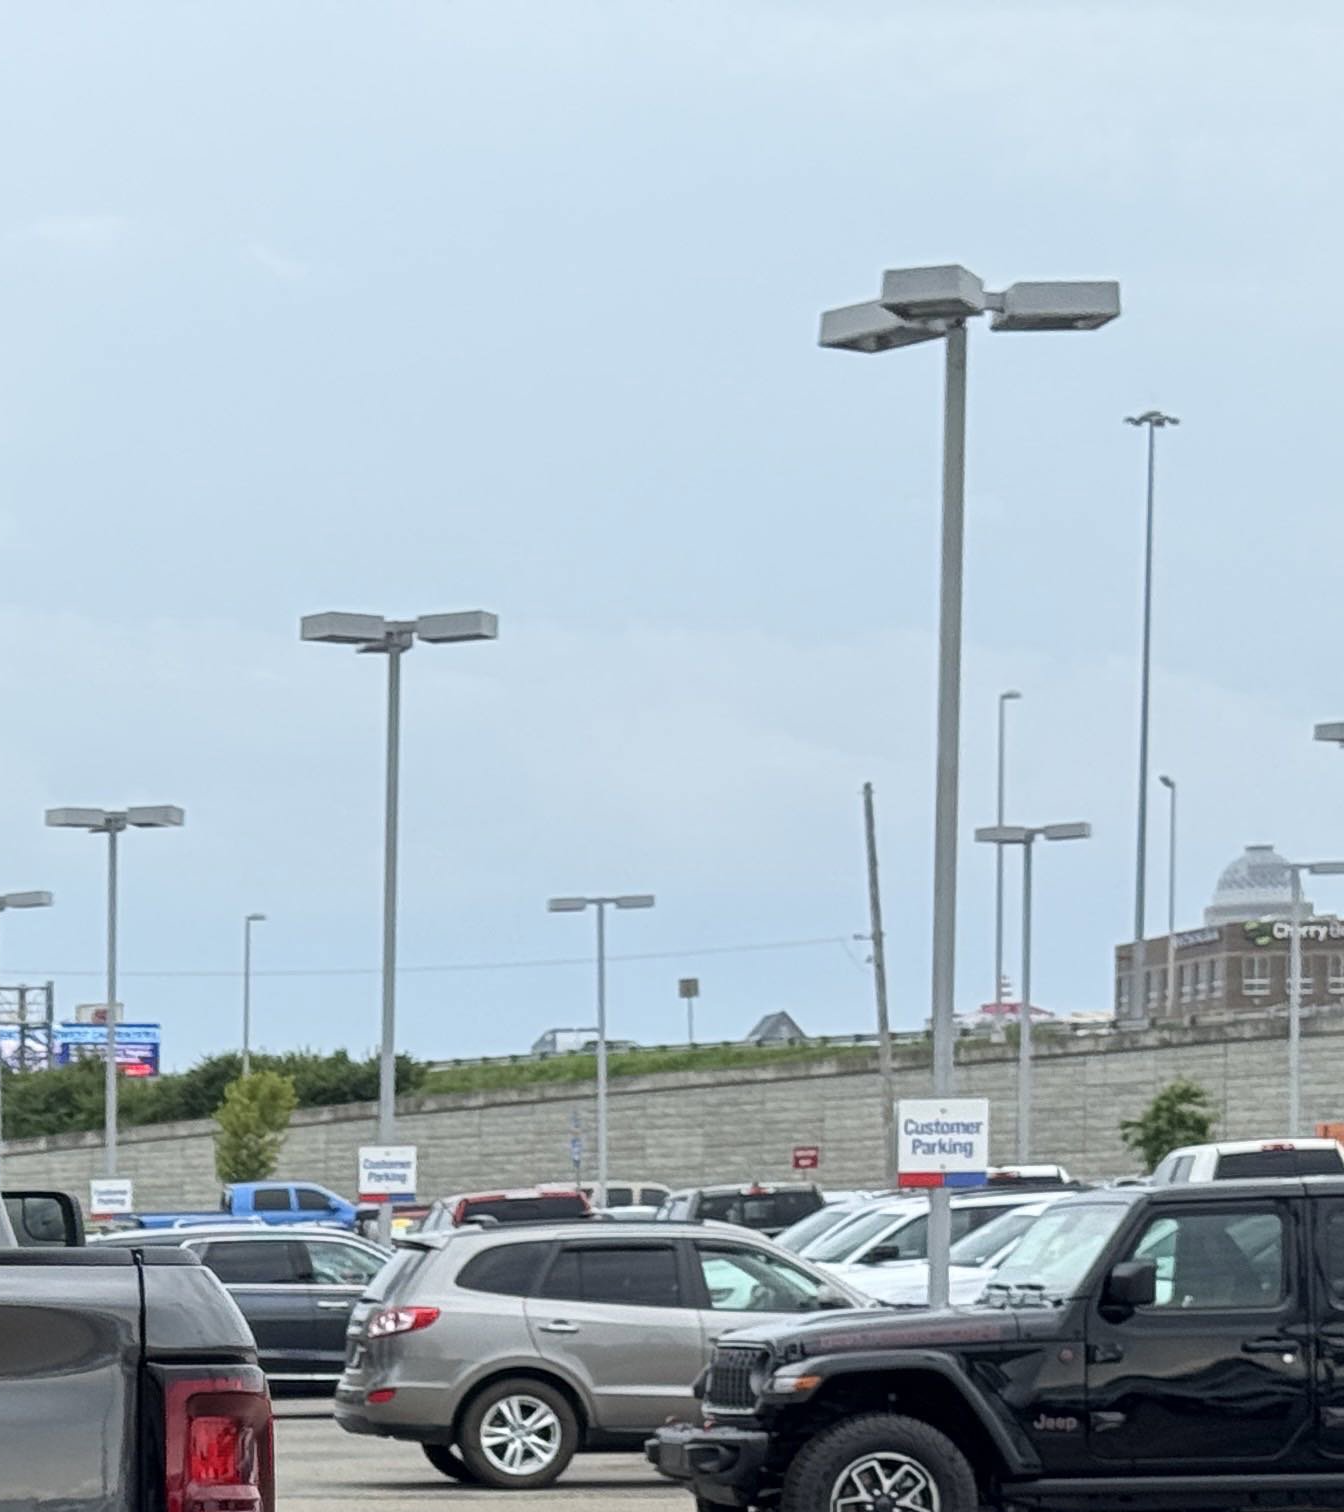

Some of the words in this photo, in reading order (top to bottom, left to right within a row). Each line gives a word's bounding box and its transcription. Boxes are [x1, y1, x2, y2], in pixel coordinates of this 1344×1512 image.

[1273, 921, 1328, 942] Chrry
[903, 1119, 984, 1136] Customer
[911, 1138, 974, 1158] Parking
[363, 1158, 412, 1170] Customer
[367, 1171, 407, 1185] Parking
[1032, 1412, 1079, 1433] Jeep
